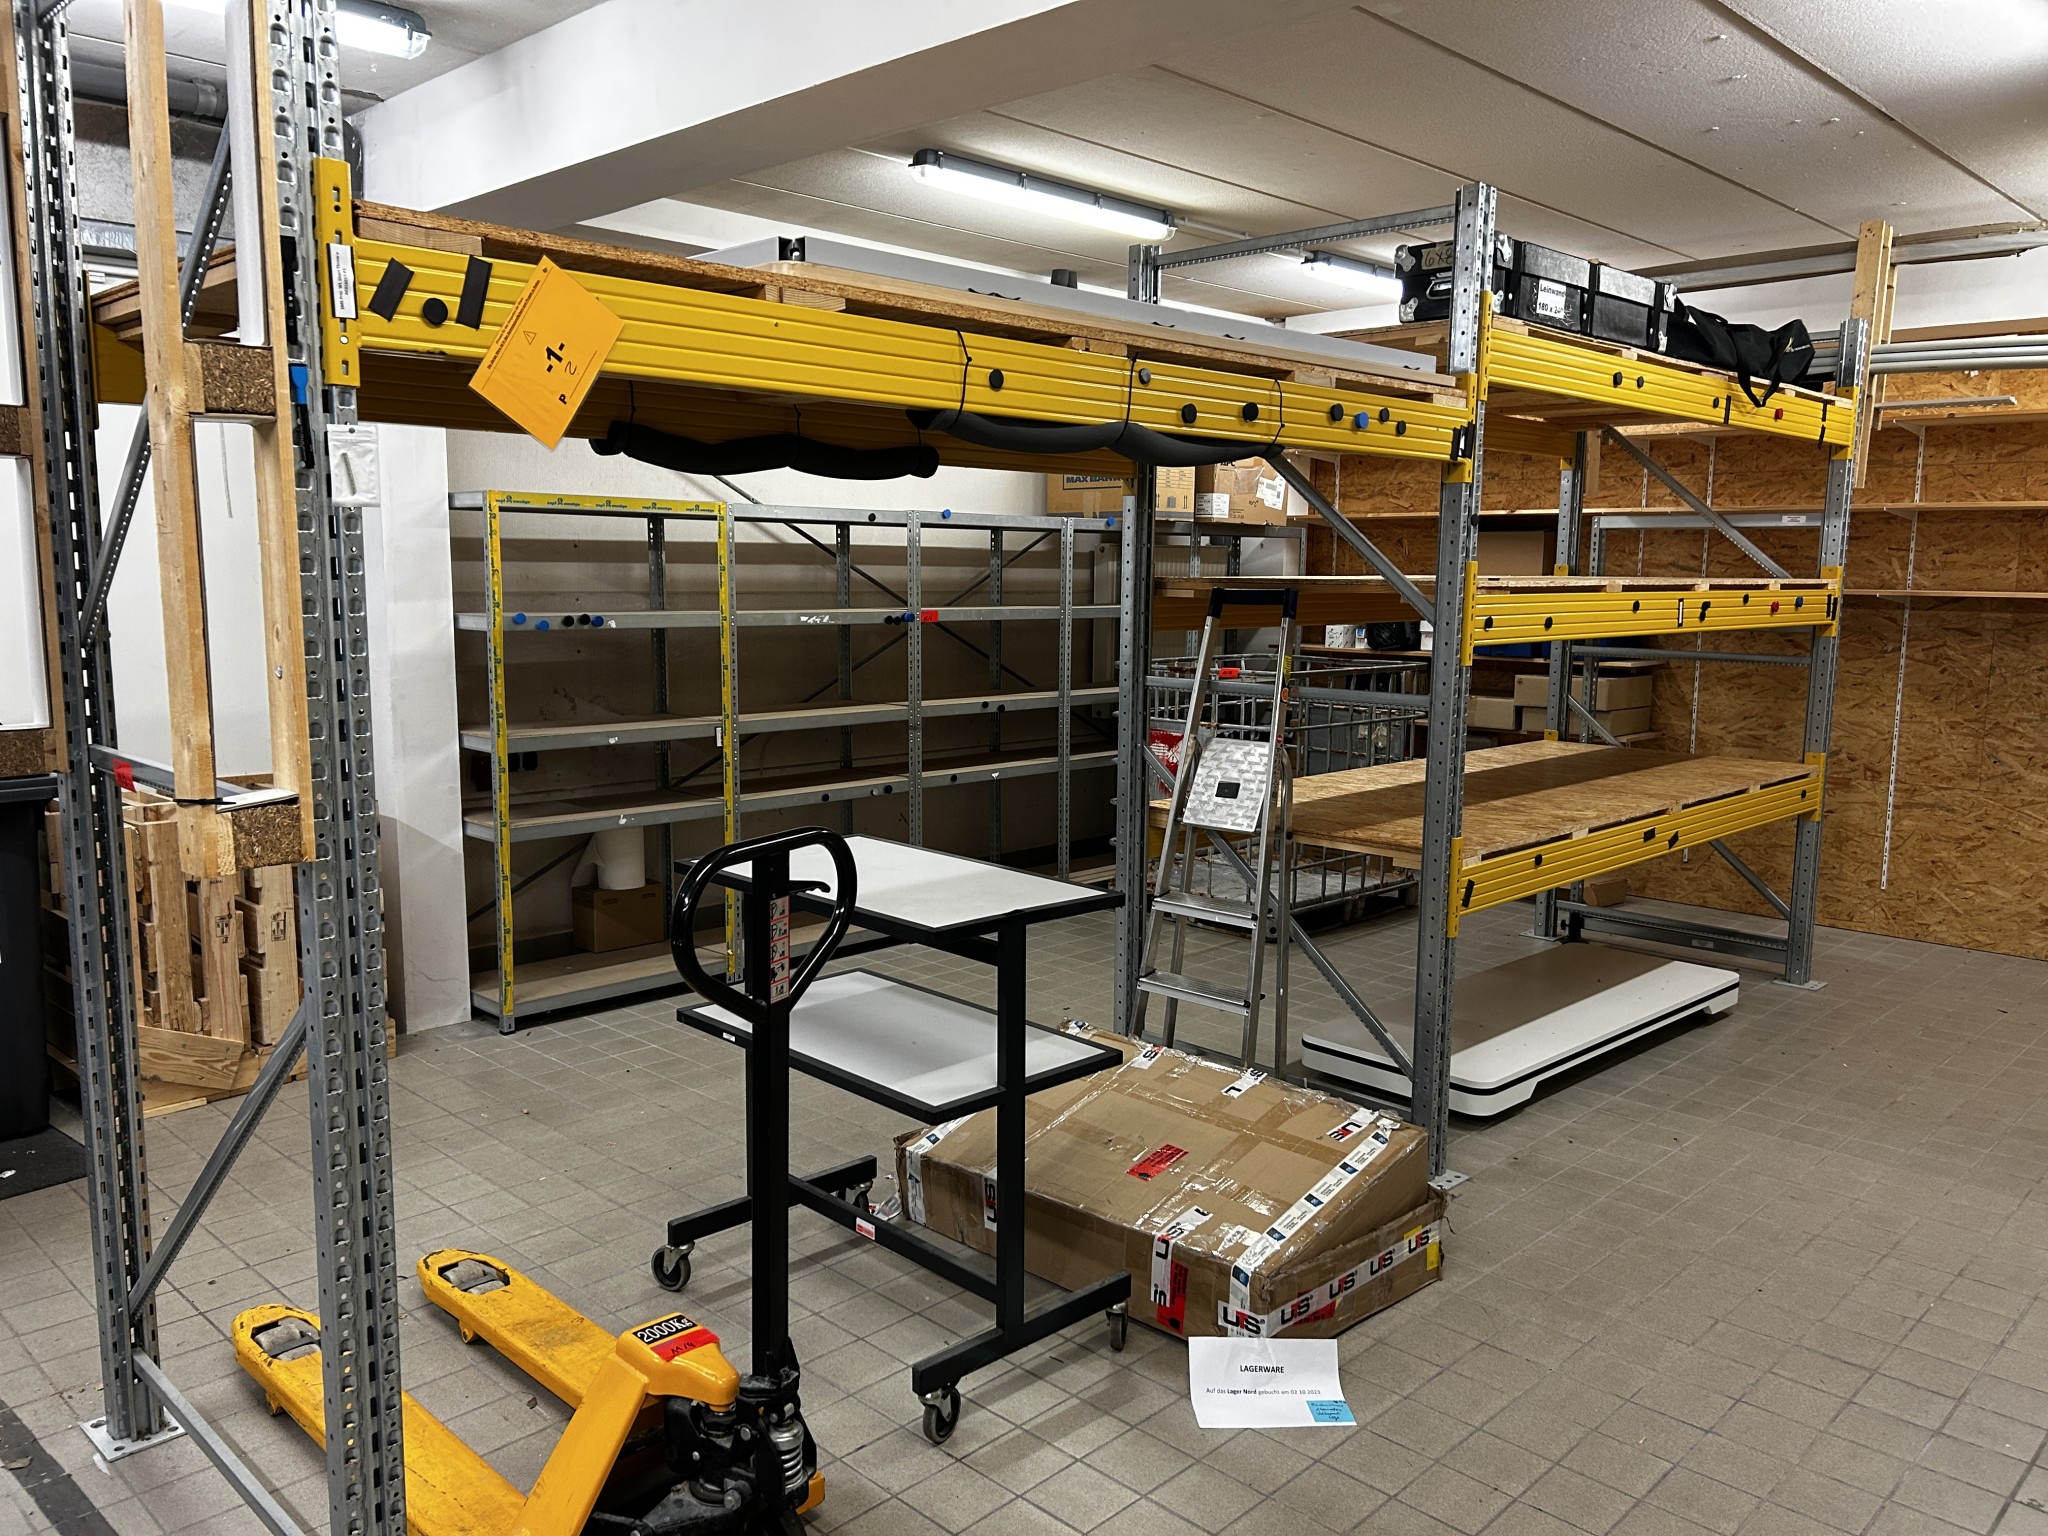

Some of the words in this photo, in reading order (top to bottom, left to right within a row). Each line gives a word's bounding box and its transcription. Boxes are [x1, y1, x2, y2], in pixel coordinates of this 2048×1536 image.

[1540, 284, 1566, 297] Leinwand
[559, 394, 567, 405] P
[1240, 1364, 1284, 1374] LAGERWARE
